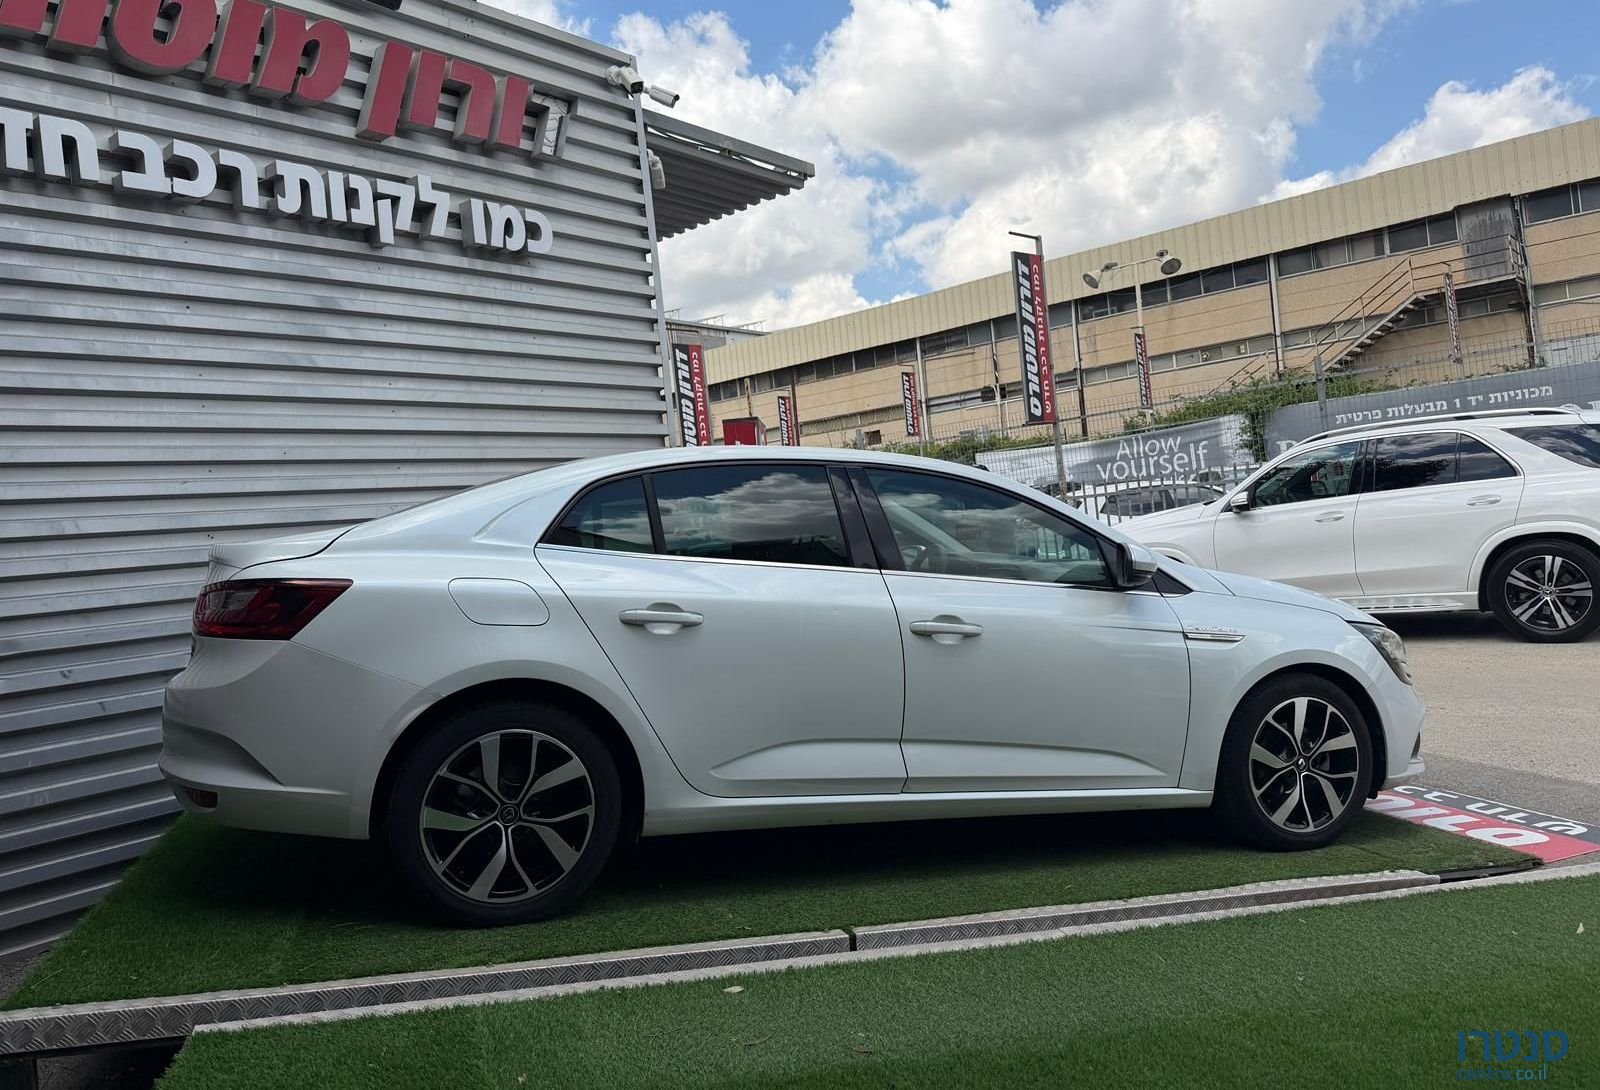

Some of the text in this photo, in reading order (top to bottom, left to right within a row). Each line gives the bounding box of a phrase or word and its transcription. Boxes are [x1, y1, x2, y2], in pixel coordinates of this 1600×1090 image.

[115, 130, 261, 209] רכב
[273, 160, 451, 245] לקנות
[468, 197, 554, 252] כמו
[1017, 258, 1042, 417] דורון מוטורס
[1040, 347, 1048, 375] רכב
[674, 348, 695, 399] דורון
[1043, 380, 1052, 413] חדש
[1097, 441, 1209, 480] yourself
[1116, 435, 1181, 460] Allow
